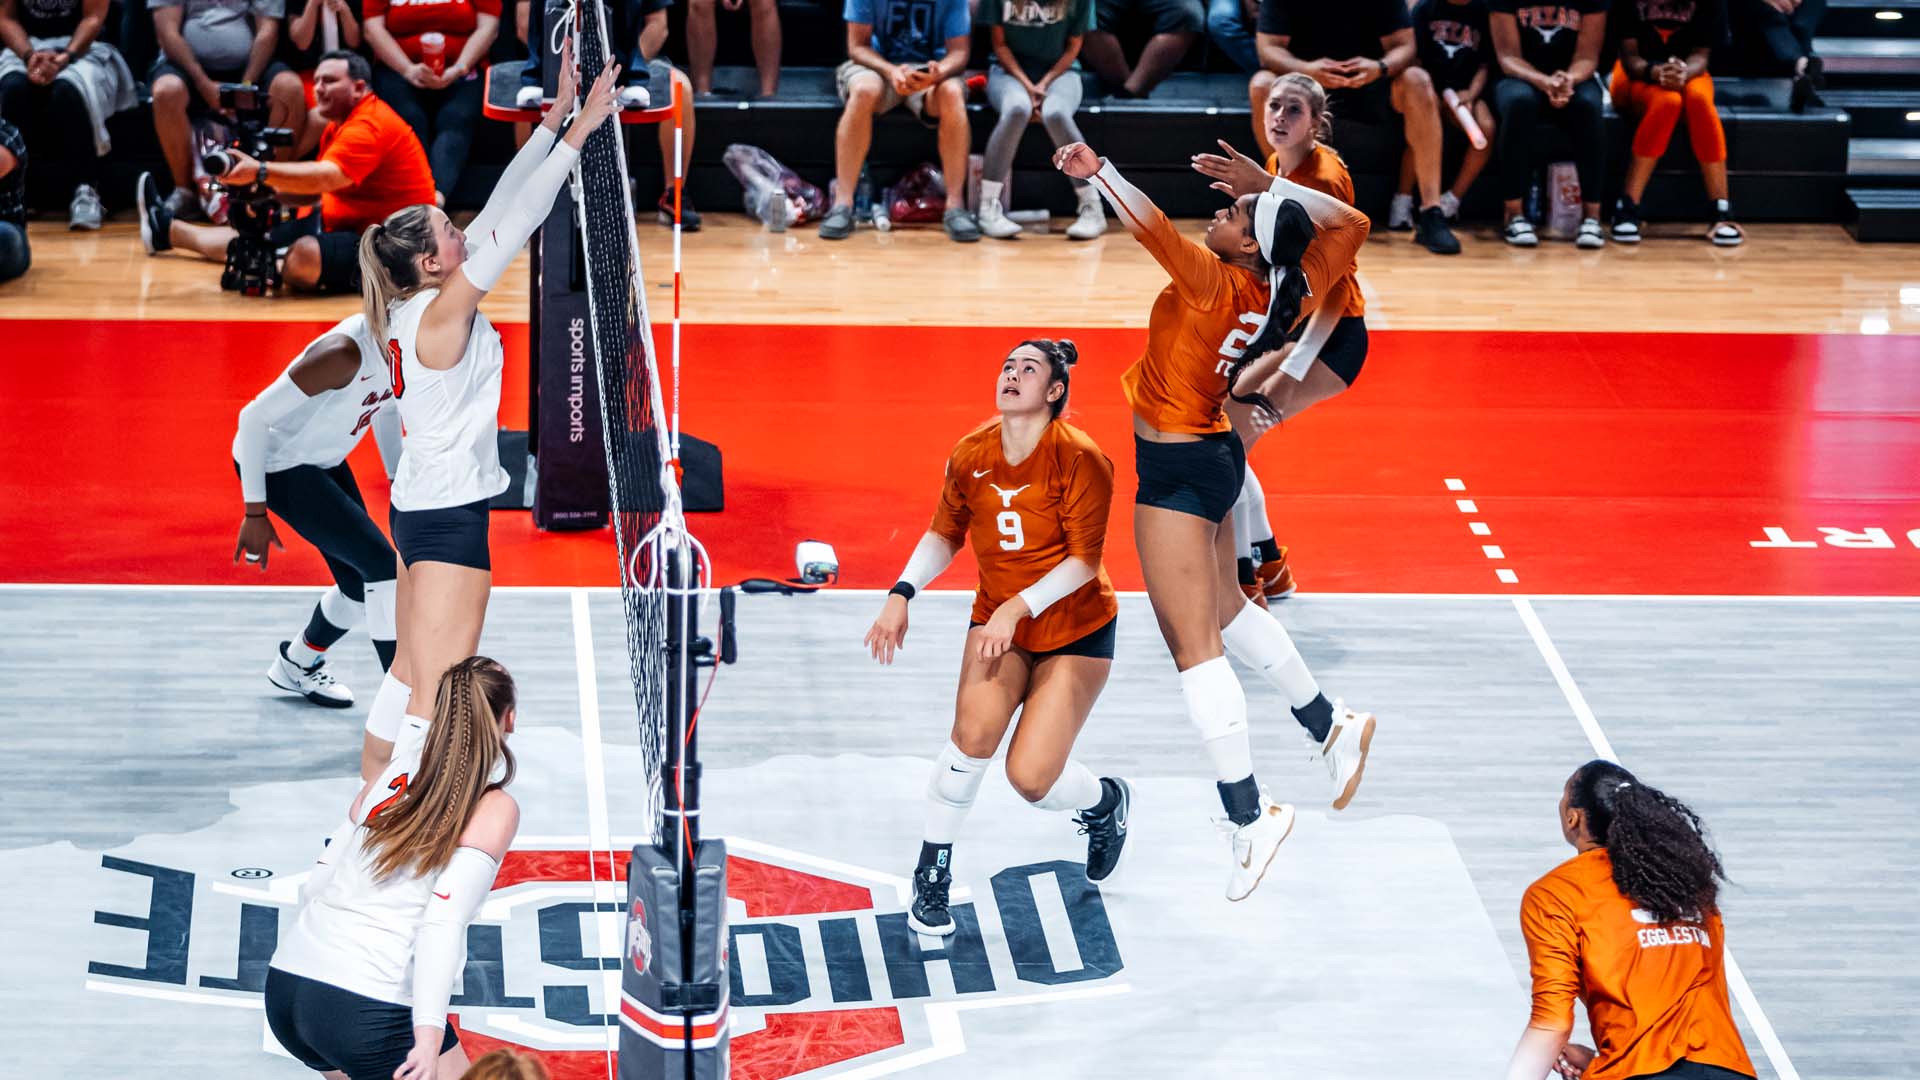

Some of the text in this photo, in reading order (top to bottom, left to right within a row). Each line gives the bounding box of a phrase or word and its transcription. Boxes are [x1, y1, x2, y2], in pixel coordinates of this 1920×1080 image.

[567, 318, 586, 443] sports imports
[996, 511, 1025, 551] 9
[1749, 526, 1920, 549] RT
[87, 854, 622, 1027] STTE
[728, 859, 1124, 1007] OHIO
[1637, 925, 1712, 949] EGGLESTN
